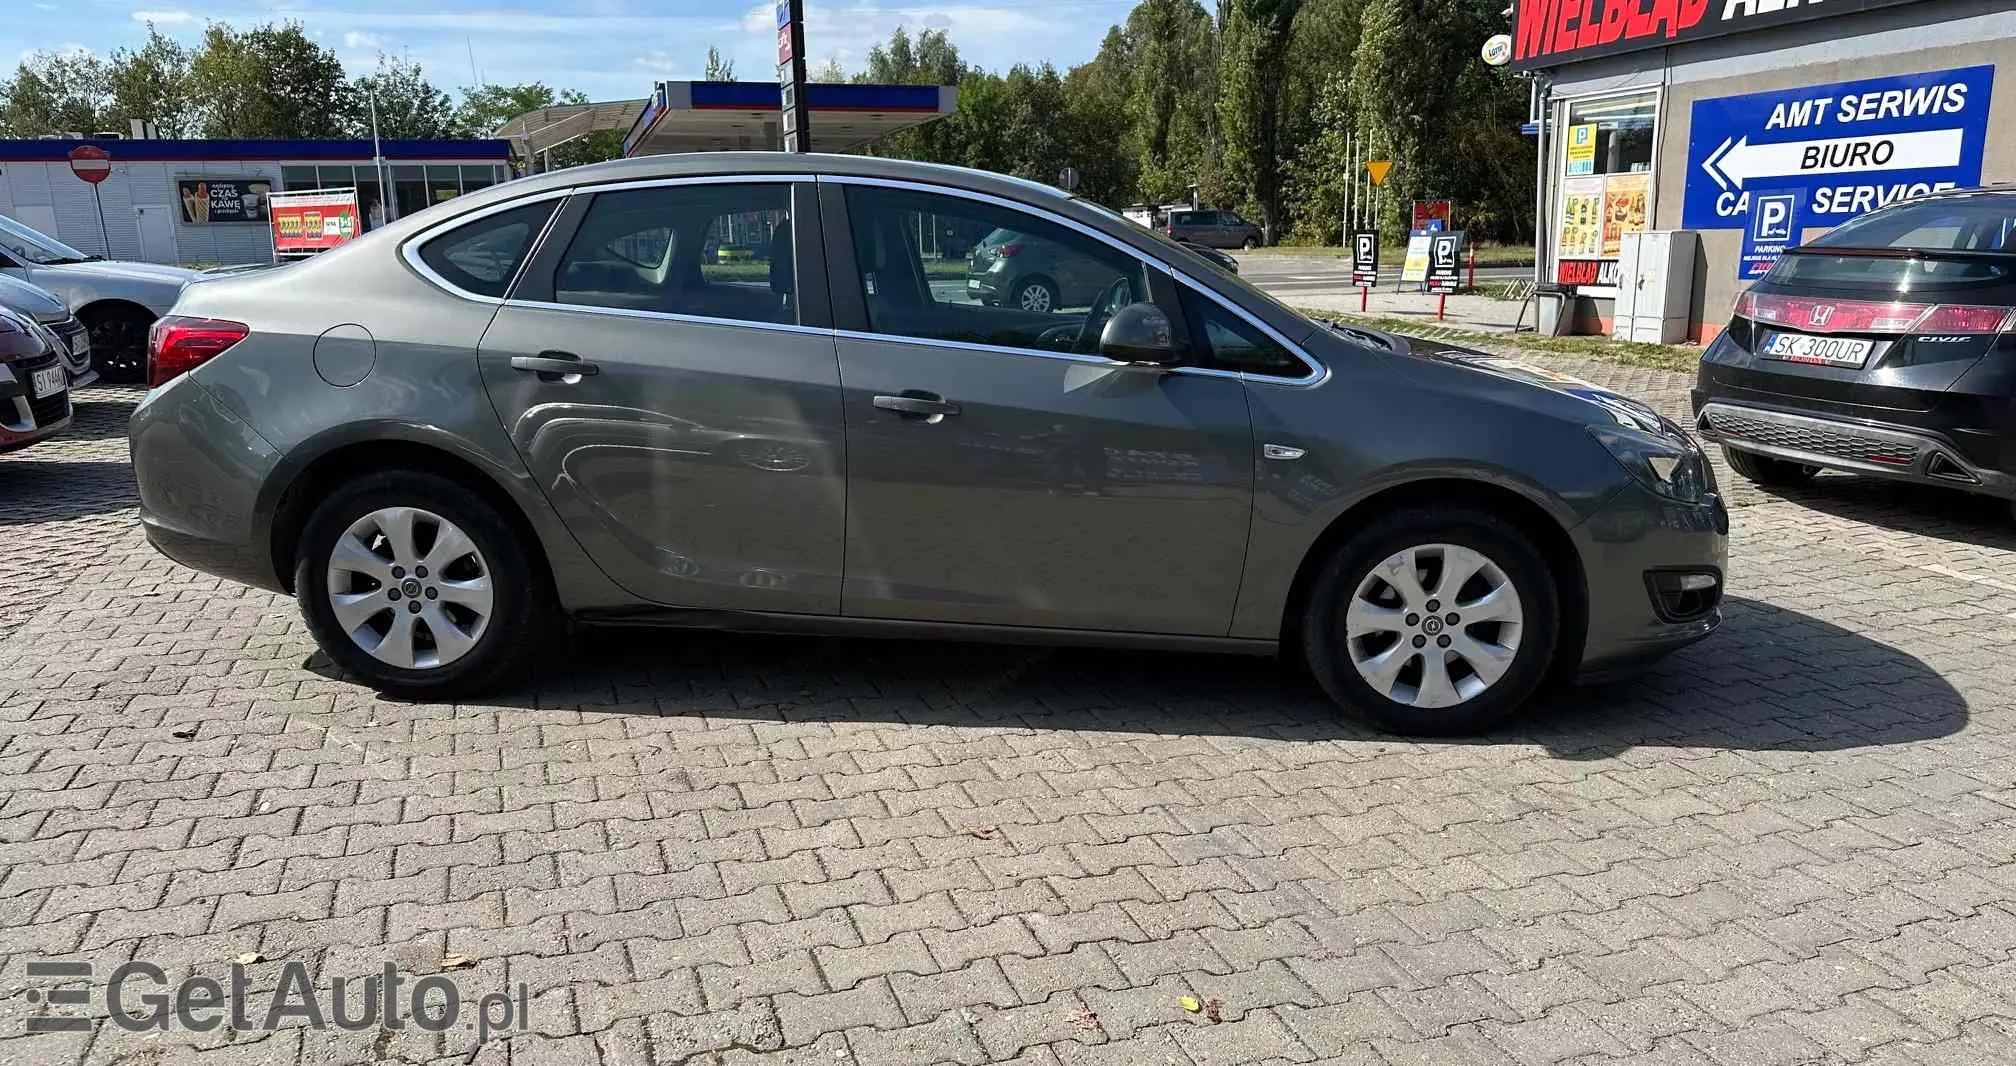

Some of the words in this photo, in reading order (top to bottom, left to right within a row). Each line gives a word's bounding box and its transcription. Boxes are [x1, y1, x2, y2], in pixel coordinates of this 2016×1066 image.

[1765, 98, 1833, 130] AMT
[1837, 83, 1968, 123] SERWIS
[1800, 139, 1895, 170] BIURO
[210, 189, 238, 198] CZAS
[210, 199, 241, 209] KAWĘ
[1716, 191, 1750, 216] CA
[1775, 336, 1801, 355] SK
[1802, 338, 1865, 362] 300UR
